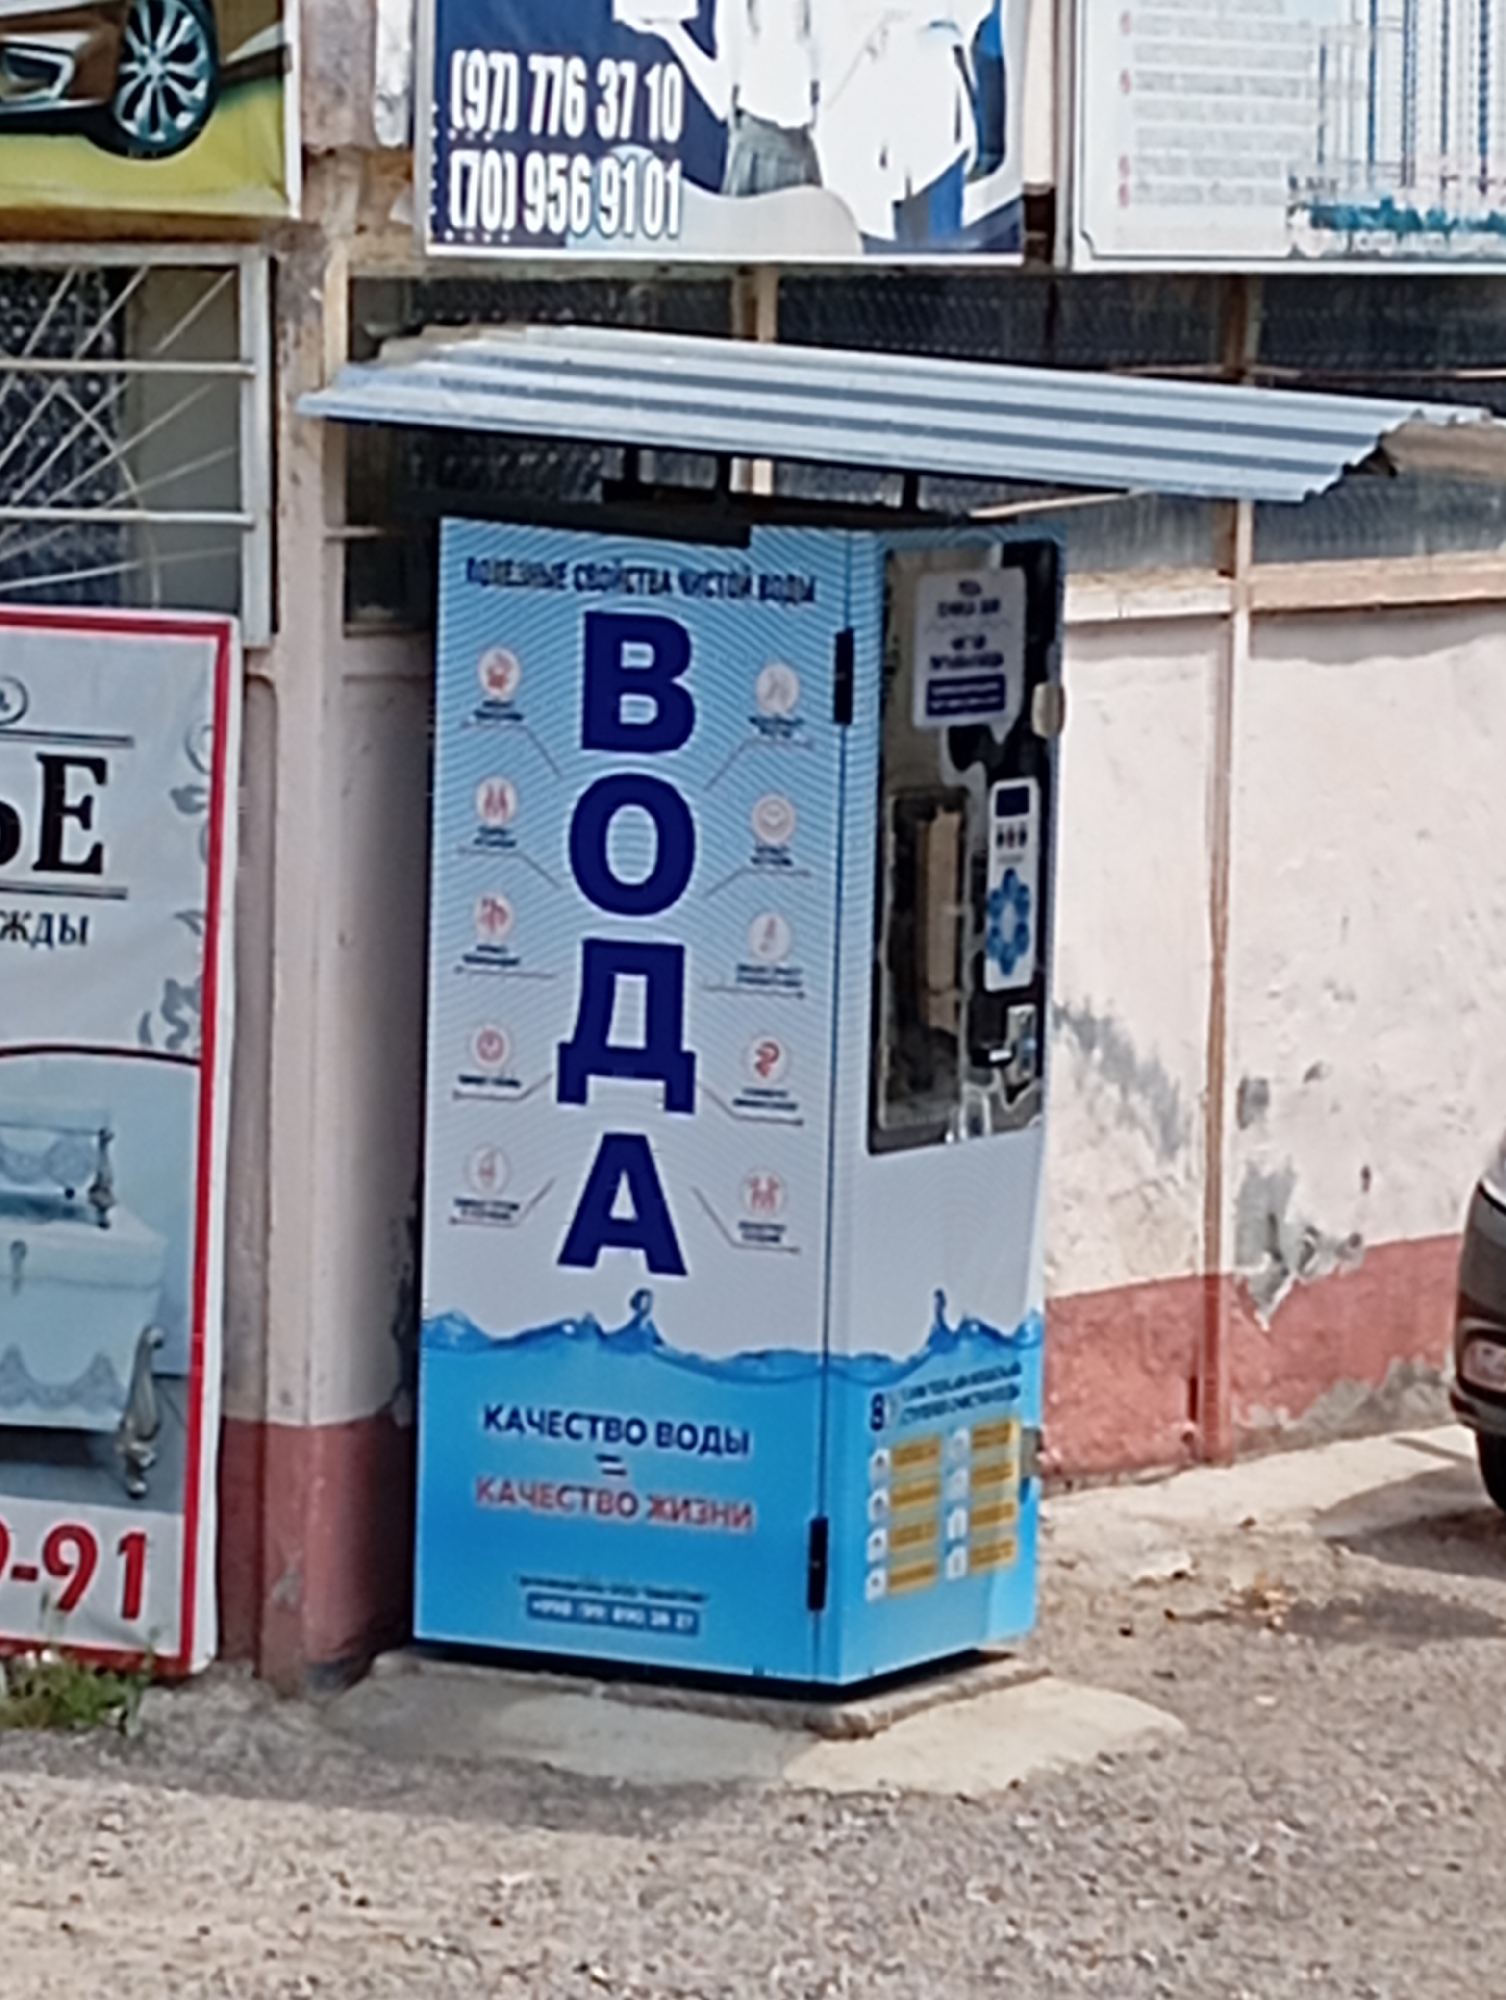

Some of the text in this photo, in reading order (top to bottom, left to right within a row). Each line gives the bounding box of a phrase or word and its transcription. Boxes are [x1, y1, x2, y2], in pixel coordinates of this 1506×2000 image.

[449, 48, 684, 142] (97) 776 37 10
[449, 149, 682, 239] (70) 956 91 01
[0, 751, 107, 875] Е
[557, 610, 698, 1277] ВОДА
[483, 1403, 750, 1457] КАЧЕСТВО ВОДЫ
[476, 1475, 754, 1529] КАЧЕСТВО ЖИЗНИ
[0, 1520, 147, 1621] -91
